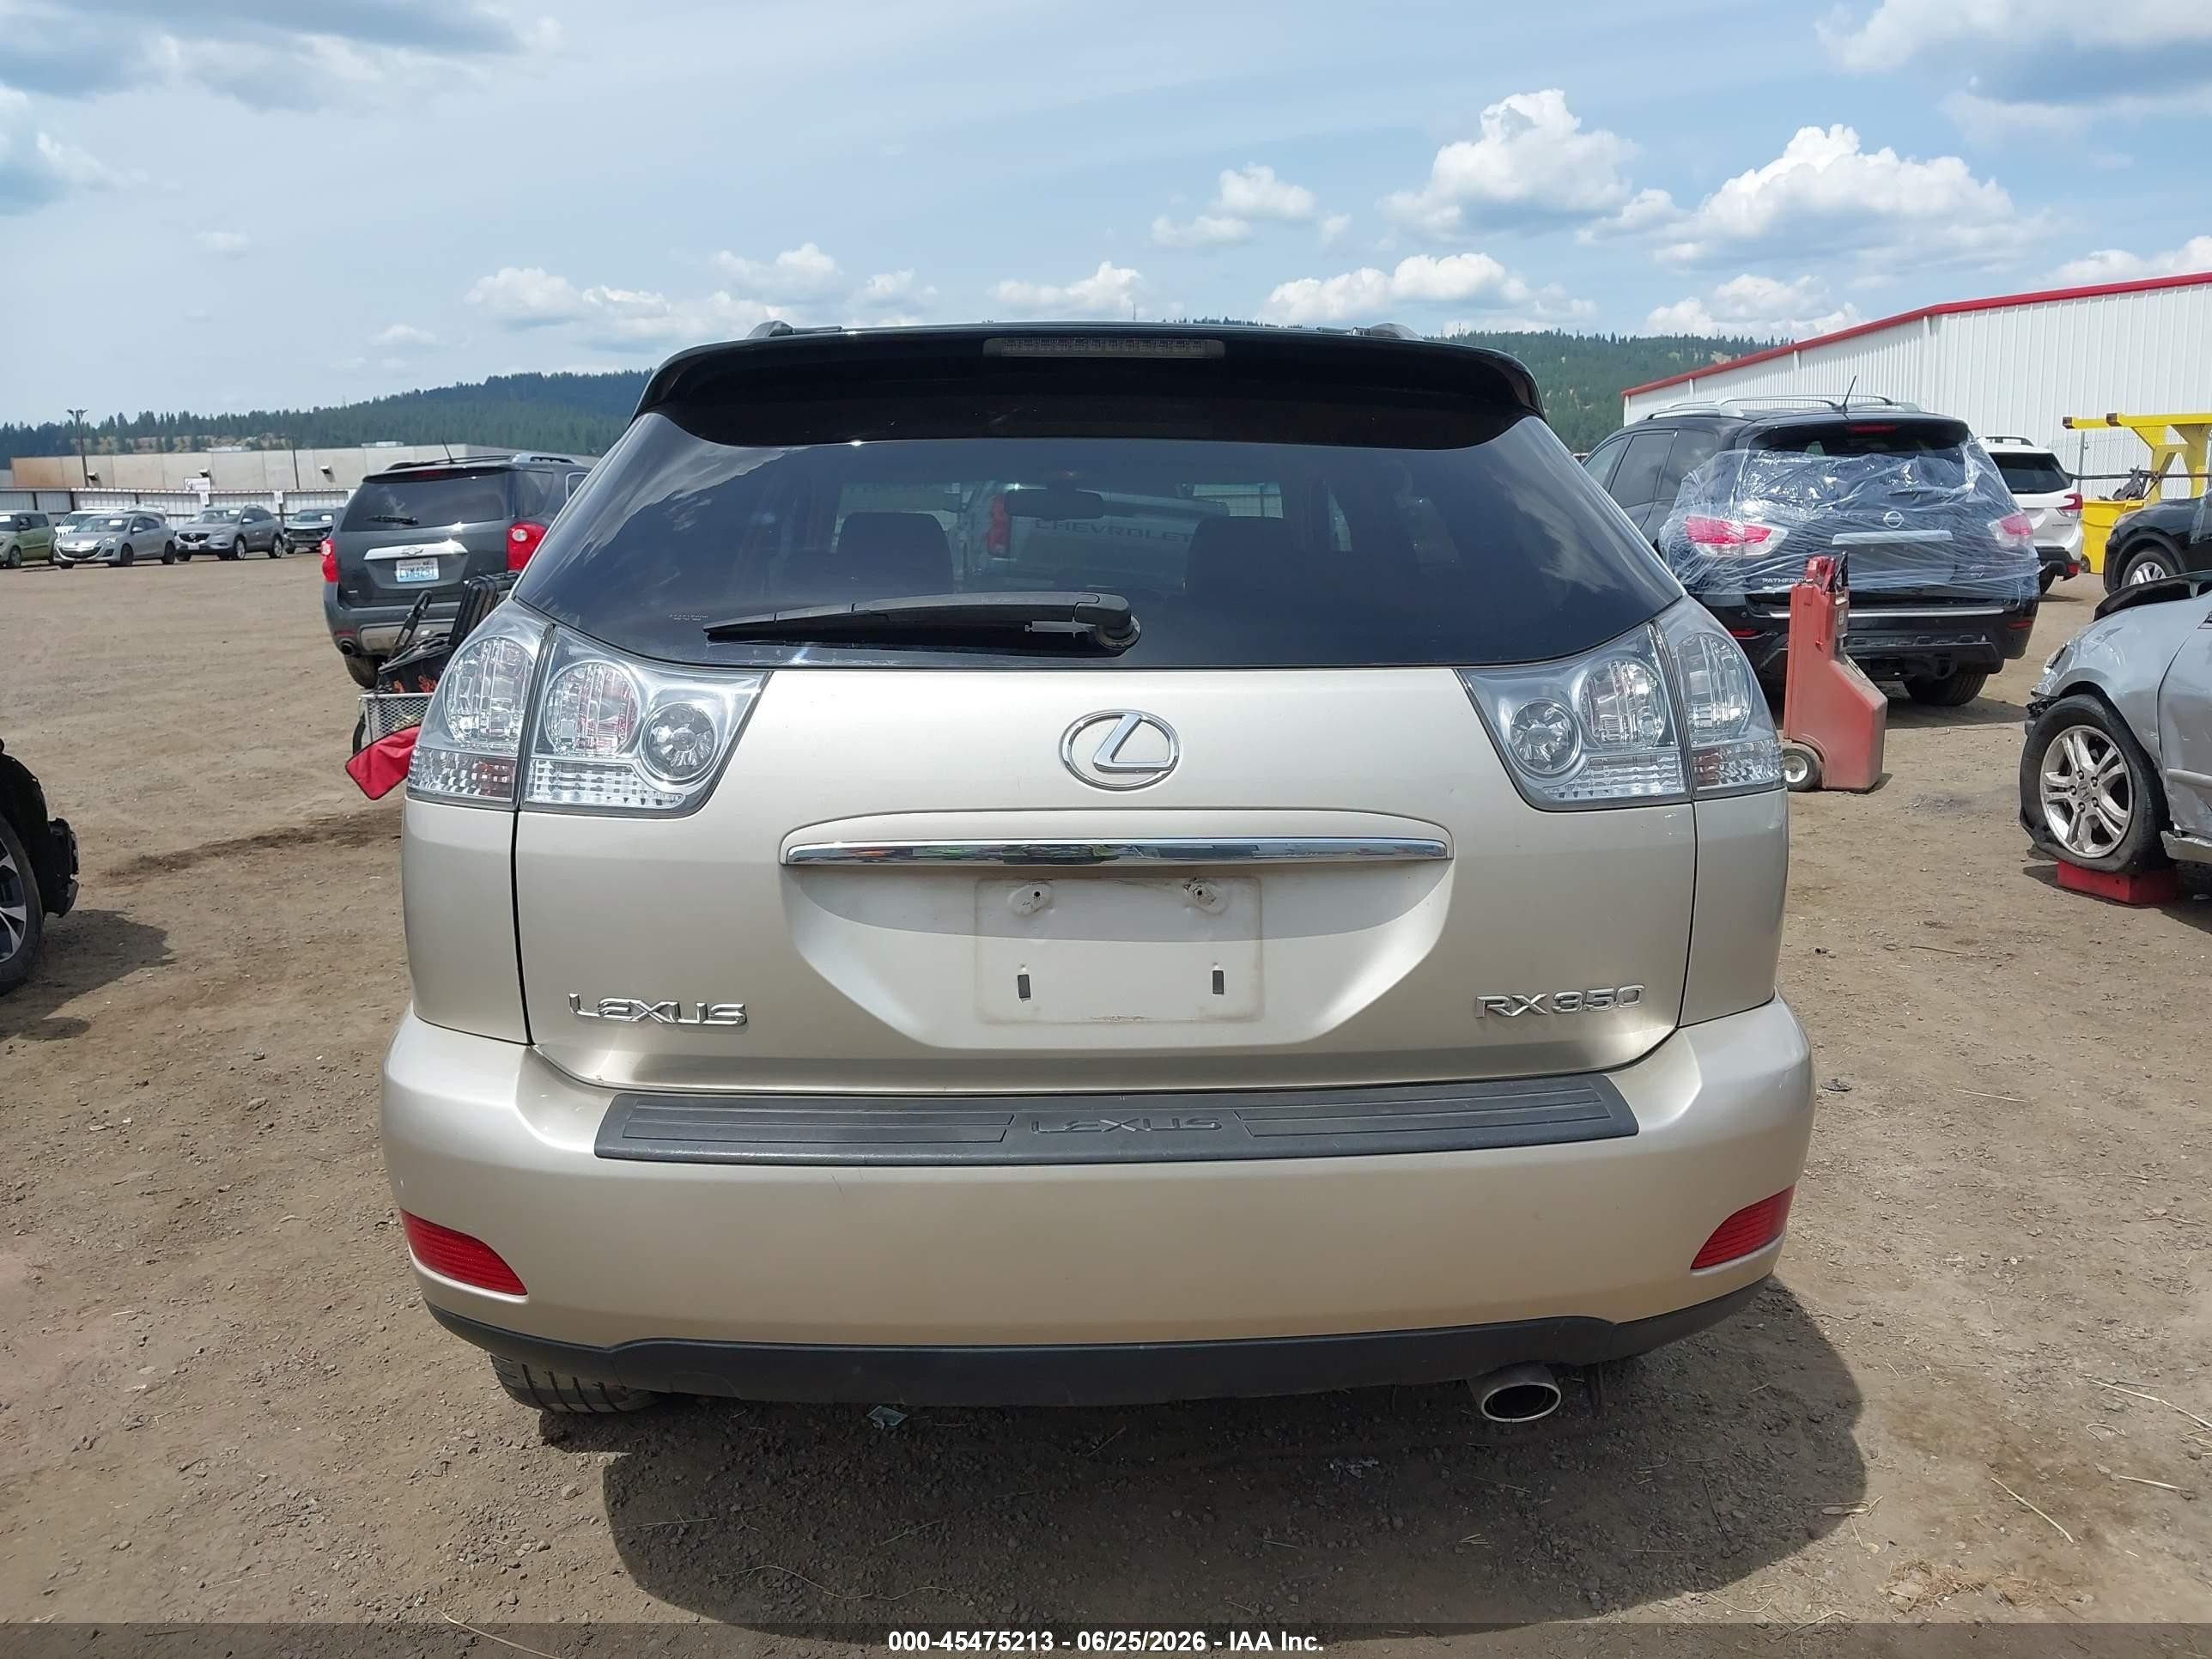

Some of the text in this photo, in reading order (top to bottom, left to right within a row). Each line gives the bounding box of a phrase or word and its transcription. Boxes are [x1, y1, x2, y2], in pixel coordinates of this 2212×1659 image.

[568, 993, 747, 1027] LEXUS
[1475, 983, 1645, 1018] RX 350
[1031, 1118, 1222, 1134] LEXUS
